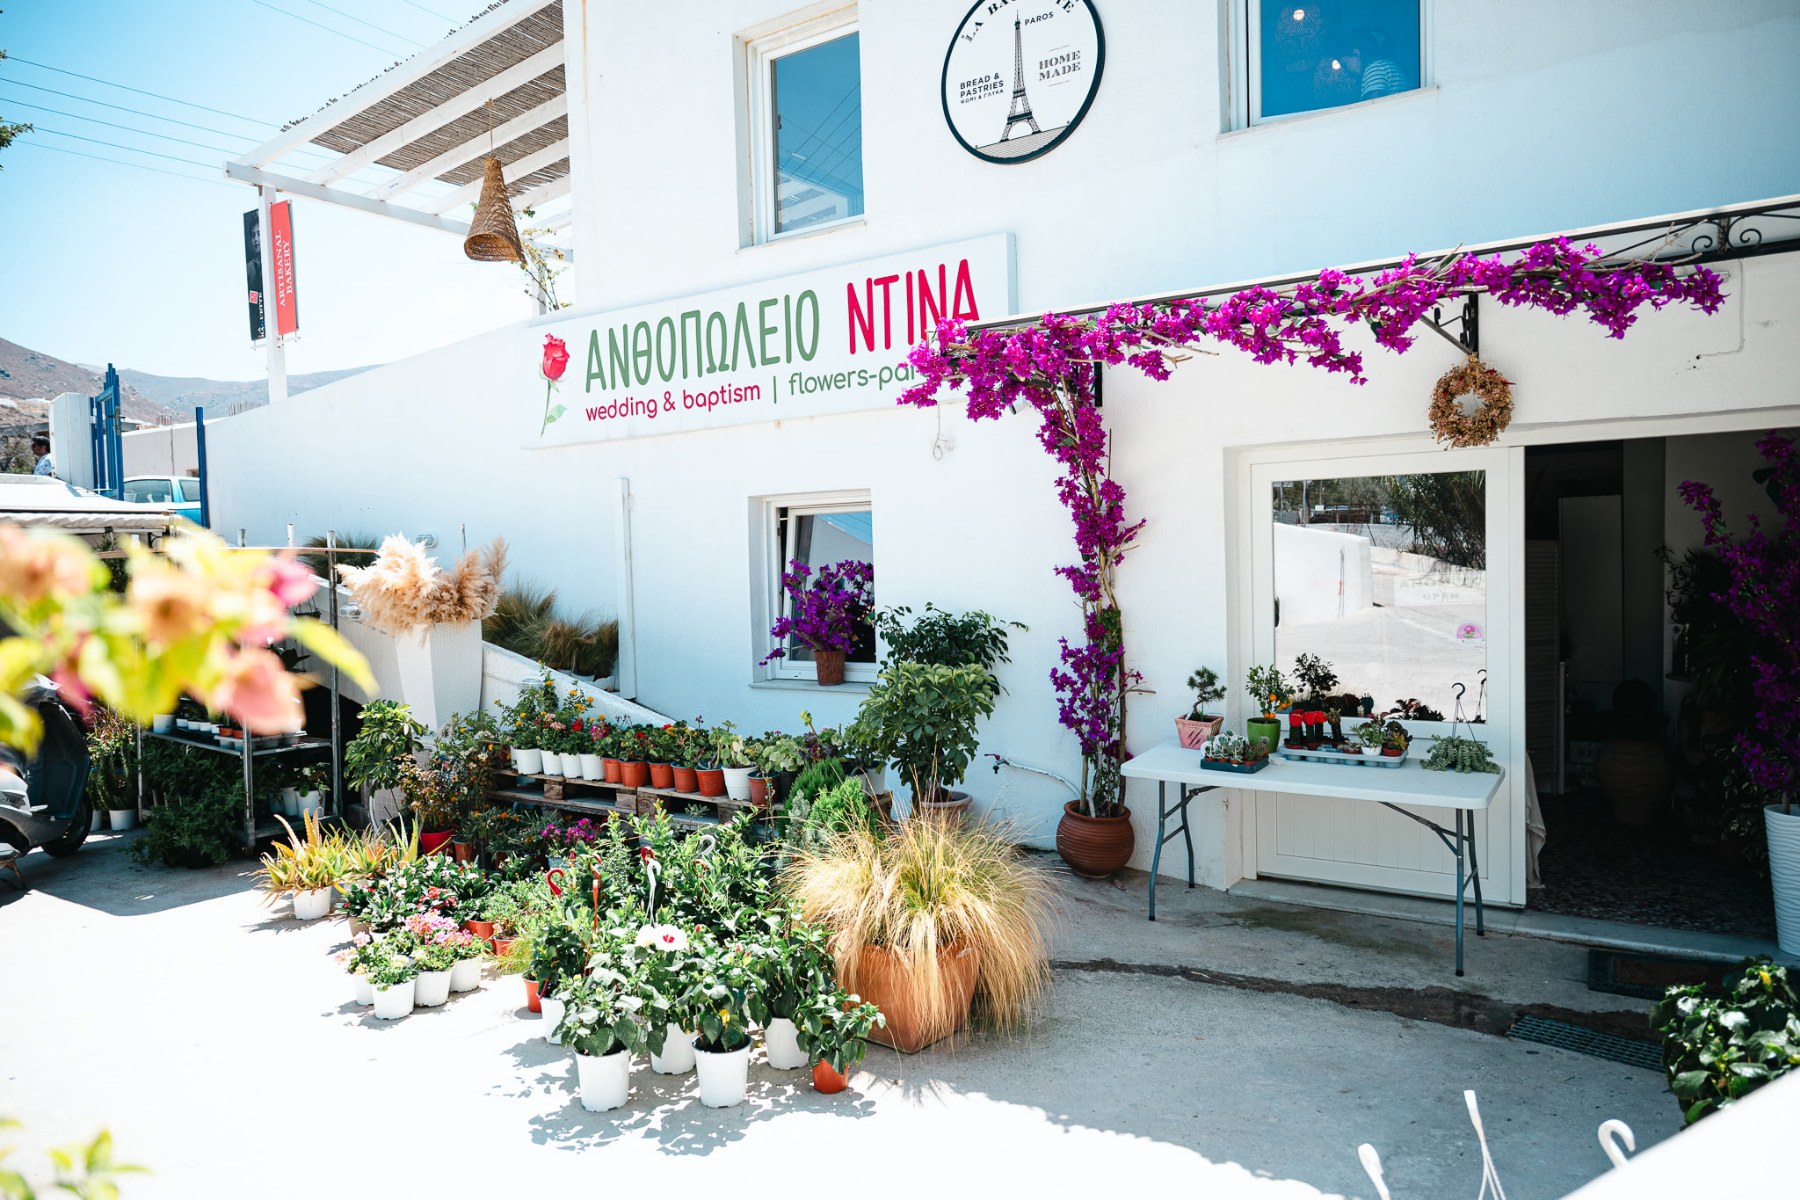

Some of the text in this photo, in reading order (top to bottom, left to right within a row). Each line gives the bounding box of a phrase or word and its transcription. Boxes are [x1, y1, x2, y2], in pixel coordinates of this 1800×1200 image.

[1024, 11, 1054, 25] PAROS
[965, 21, 983, 42] LA
[1039, 50, 1081, 70] HOME
[1039, 61, 1081, 81] MADE
[960, 75, 990, 90] BREAD
[960, 80, 1004, 98] PASTRIES
[276, 229, 286, 307] ARTISANAL
[283, 240, 293, 294] BAKERY
[585, 258, 979, 393] ΑΝΘΟΠΩΛΕΙΟ ΝΤΙΝΑ
[586, 399, 658, 421] wedding
[663, 391, 676, 412] &
[683, 382, 760, 412] baptism
